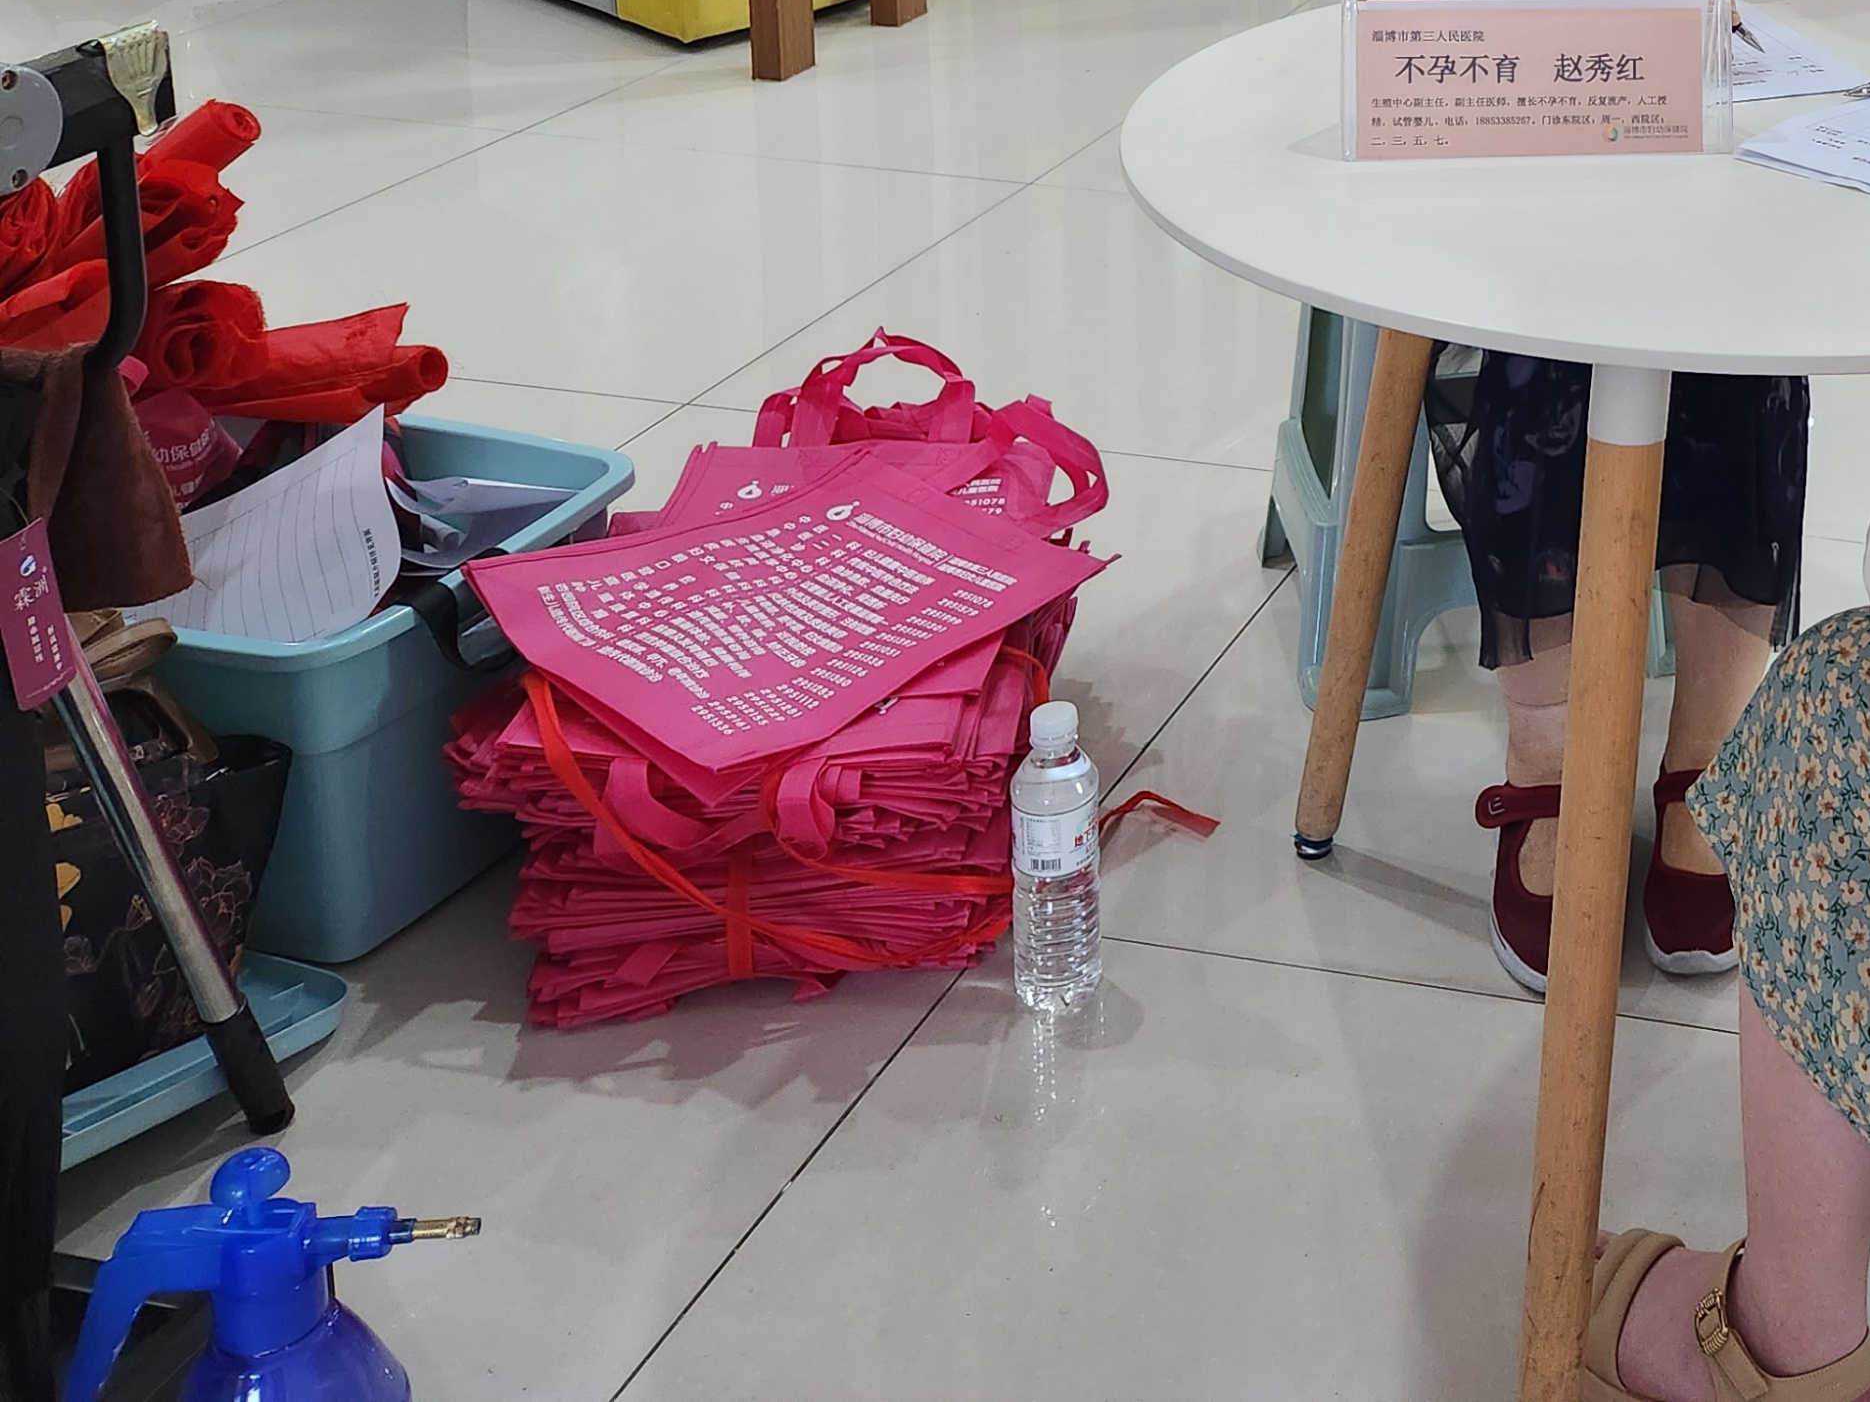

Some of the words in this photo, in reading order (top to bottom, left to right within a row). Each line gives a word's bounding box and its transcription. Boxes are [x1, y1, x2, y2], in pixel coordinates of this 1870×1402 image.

[1372, 30, 1485, 42] 淄博市第三人民医院
[1395, 54, 1520, 84] 不孕不育
[1554, 53, 1645, 83] 赵秀红
[726, 696, 769, 726] 2952155
[743, 691, 786, 722] 2951229
[776, 684, 820, 709] 2951112
[691, 705, 734, 735] 2951336
[708, 700, 751, 732] 2952161
